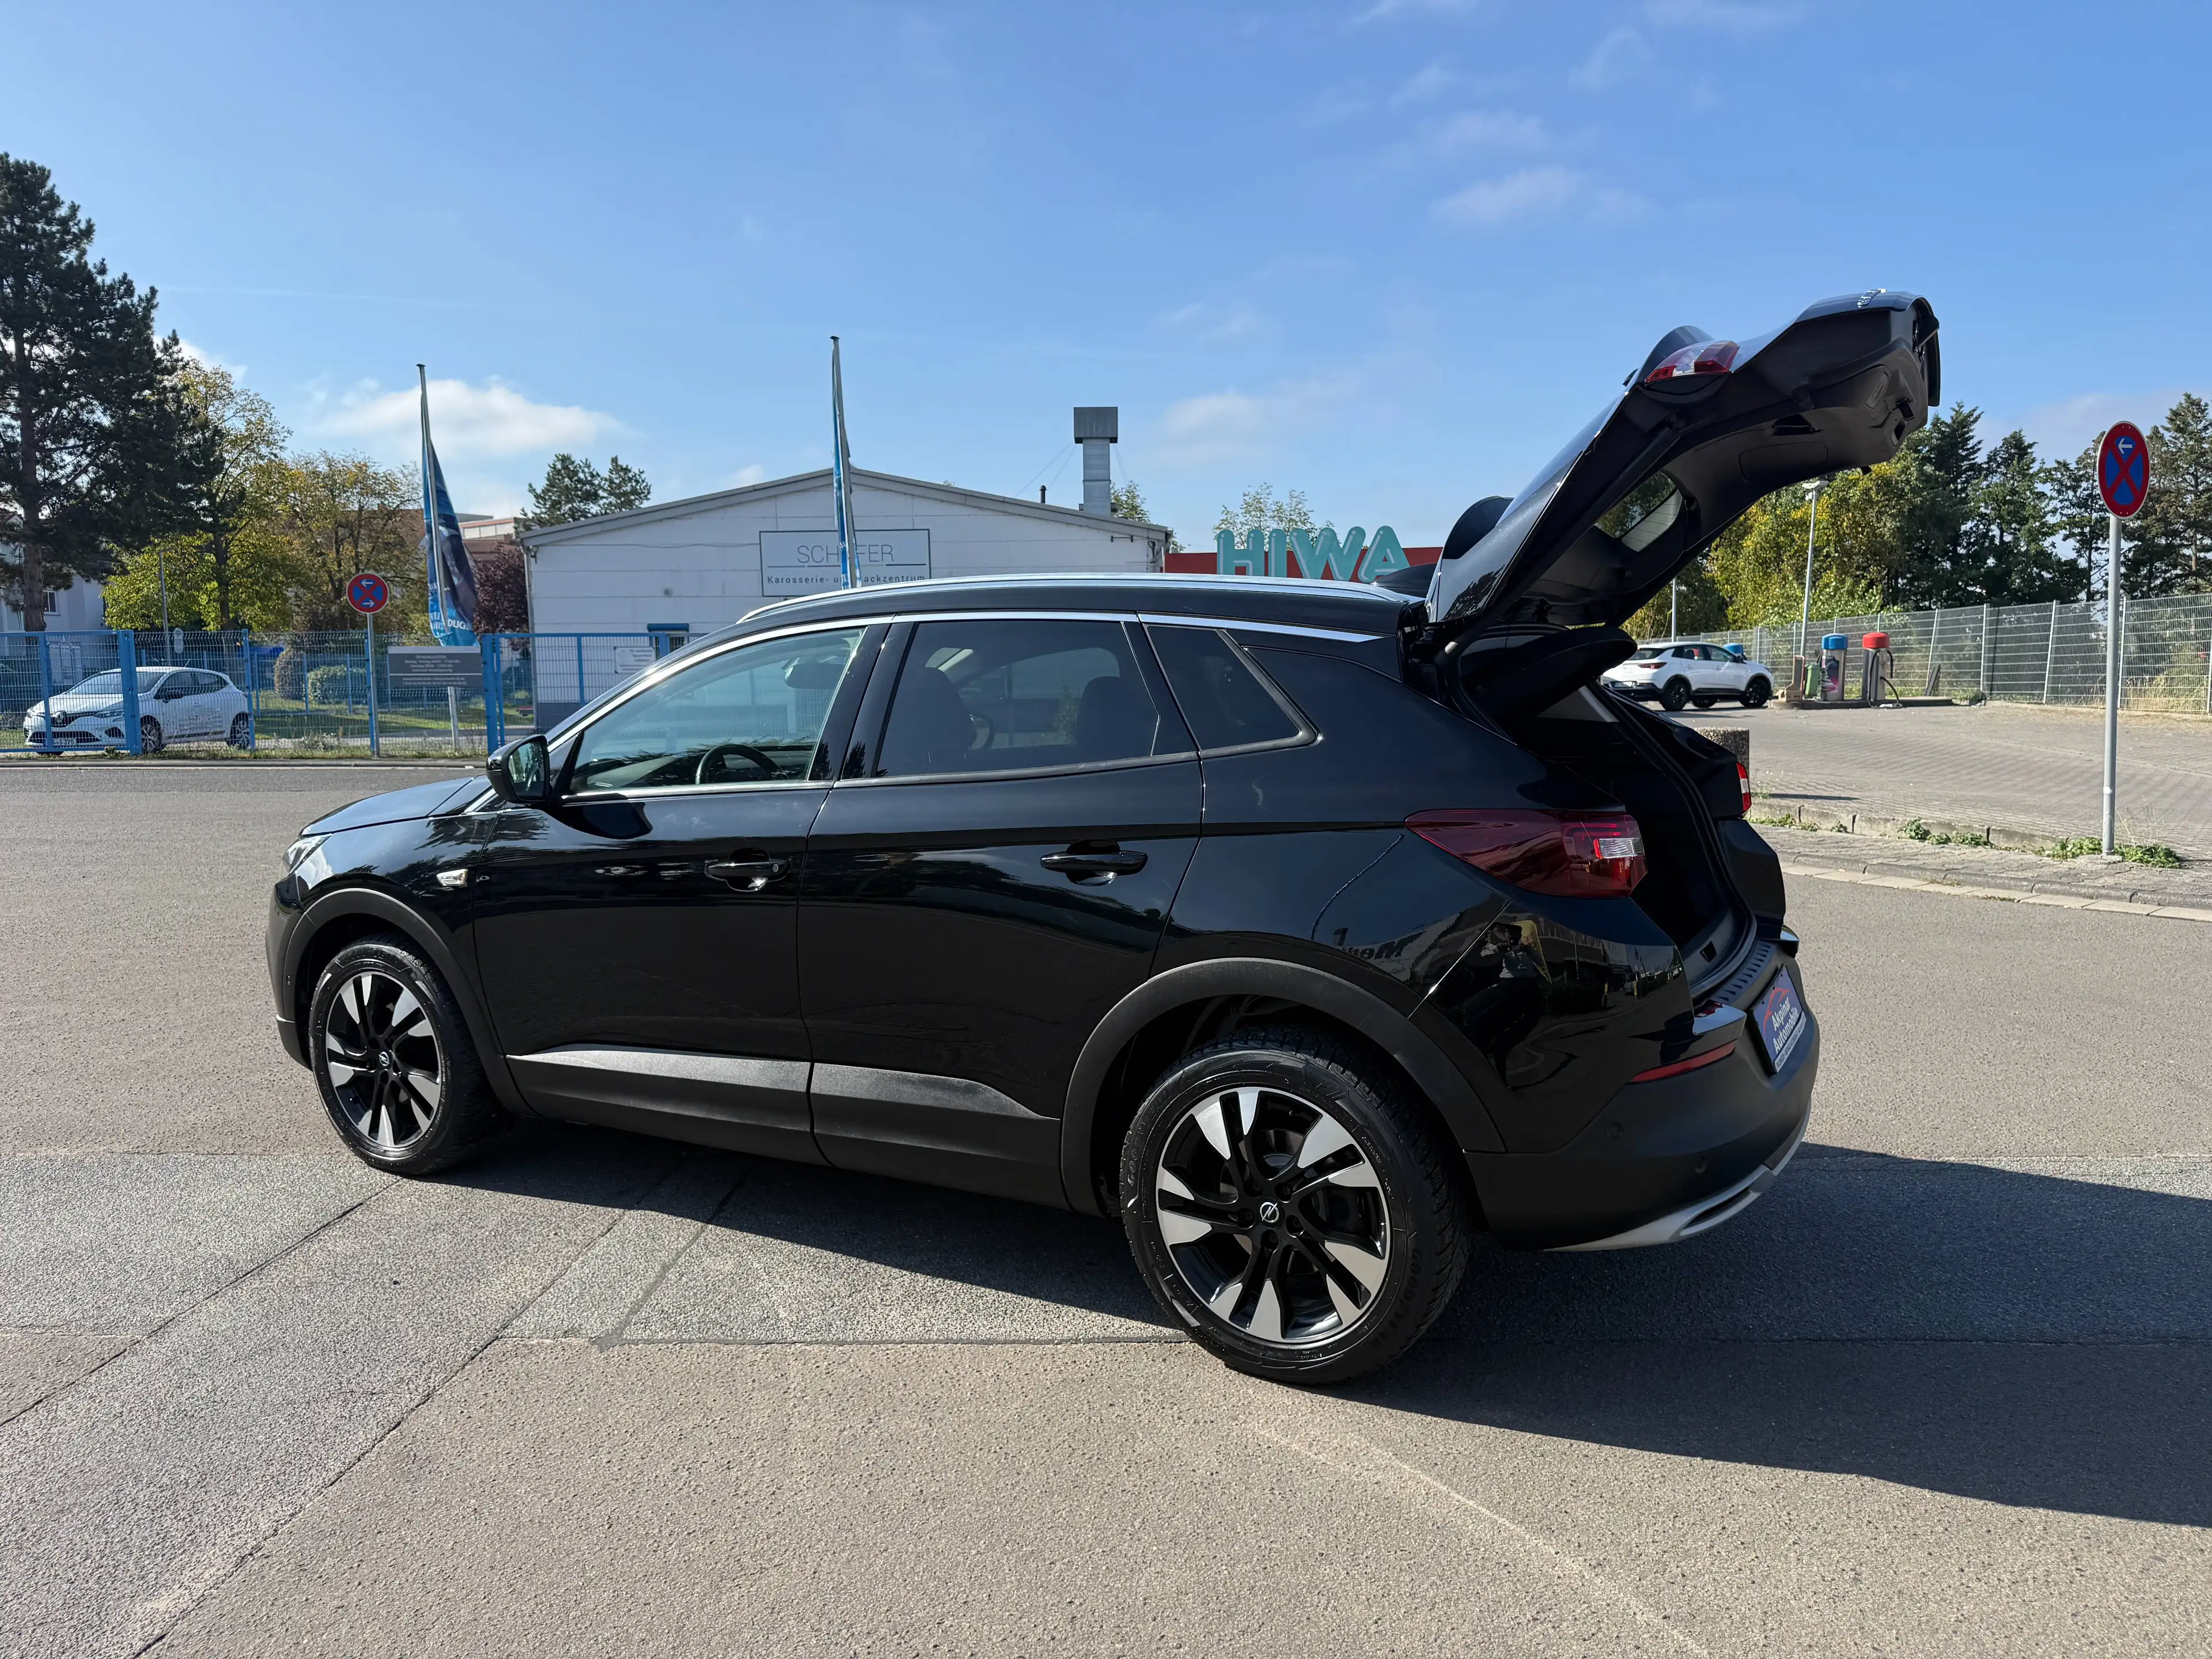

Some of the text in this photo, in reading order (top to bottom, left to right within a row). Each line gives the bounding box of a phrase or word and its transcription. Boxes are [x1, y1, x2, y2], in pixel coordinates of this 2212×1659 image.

[797, 545, 894, 563] SCHFER
[1217, 525, 1410, 582] HIWA
[864, 575, 925, 583] ackzentrum
[1772, 997, 1791, 1031] Akpinar
[1773, 1007, 1799, 1055] Automobile
